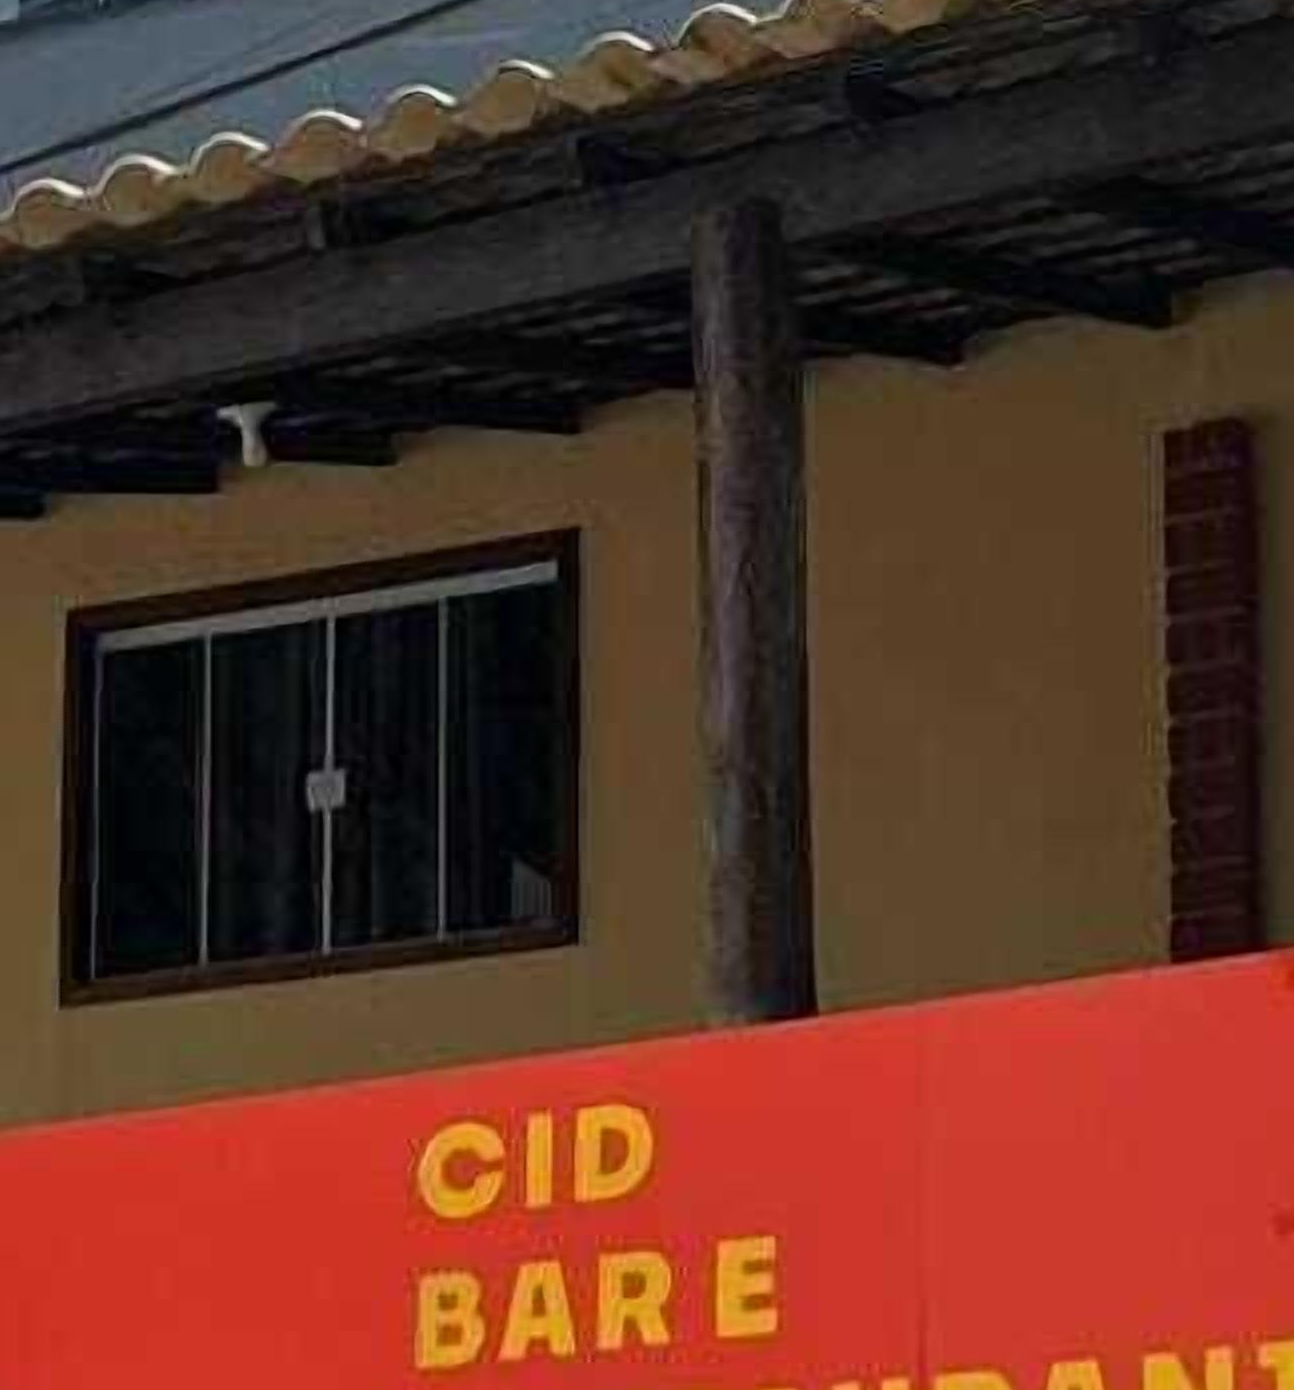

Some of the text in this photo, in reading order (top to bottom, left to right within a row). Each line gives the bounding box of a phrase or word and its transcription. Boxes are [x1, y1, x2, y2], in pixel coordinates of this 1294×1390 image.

[417, 1104, 653, 1218] CID
[415, 1236, 778, 1368] BAR E
